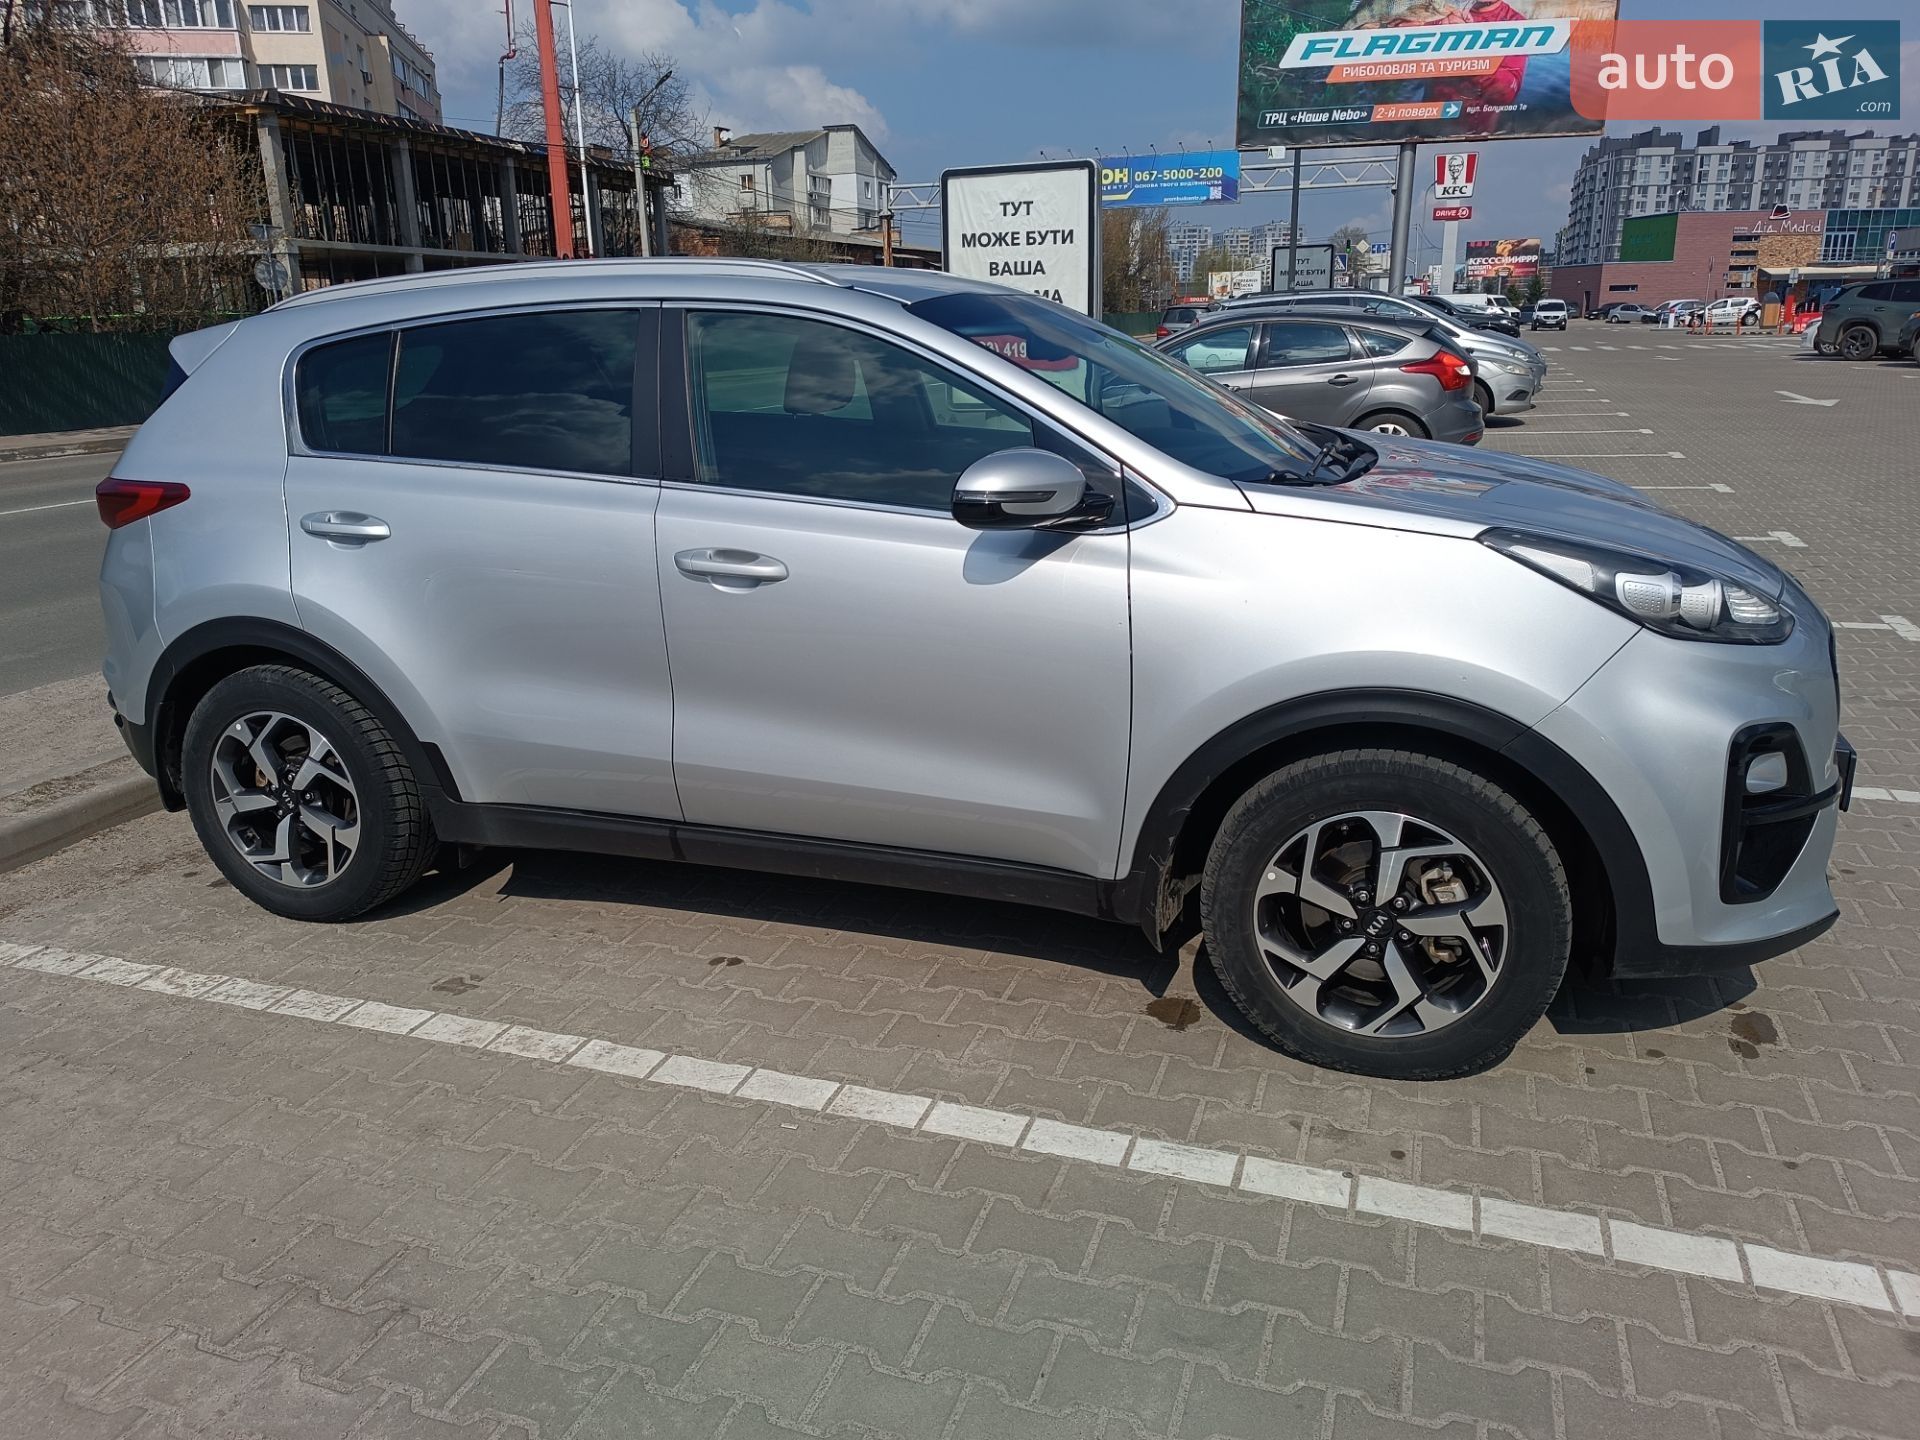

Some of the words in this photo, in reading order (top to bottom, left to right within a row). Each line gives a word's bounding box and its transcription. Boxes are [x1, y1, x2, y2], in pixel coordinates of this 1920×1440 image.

[1299, 25, 1555, 61] FLAGMAN
[1342, 63, 1417, 78] РИБОЛОВЛЯ
[1420, 62, 1435, 73] ТА
[1438, 59, 1490, 72] ТУРИЗМ
[1265, 113, 1287, 126] ТРЦ
[1290, 111, 1329, 124] «Наше
[1376, 107, 1395, 119] 2-й
[1398, 105, 1438, 118] поверх
[1134, 167, 1223, 182] 067-5000-200
[1441, 185, 1468, 196] KFC
[999, 200, 1034, 217] ТУТ
[1435, 209, 1457, 217] DRIVE
[961, 231, 1021, 248] МОЖЕ
[1025, 229, 1074, 246] БУТИ
[989, 260, 1046, 277] ВАША
[1003, 341, 1027, 358] 419
[1366, 915, 1389, 935] KIA
